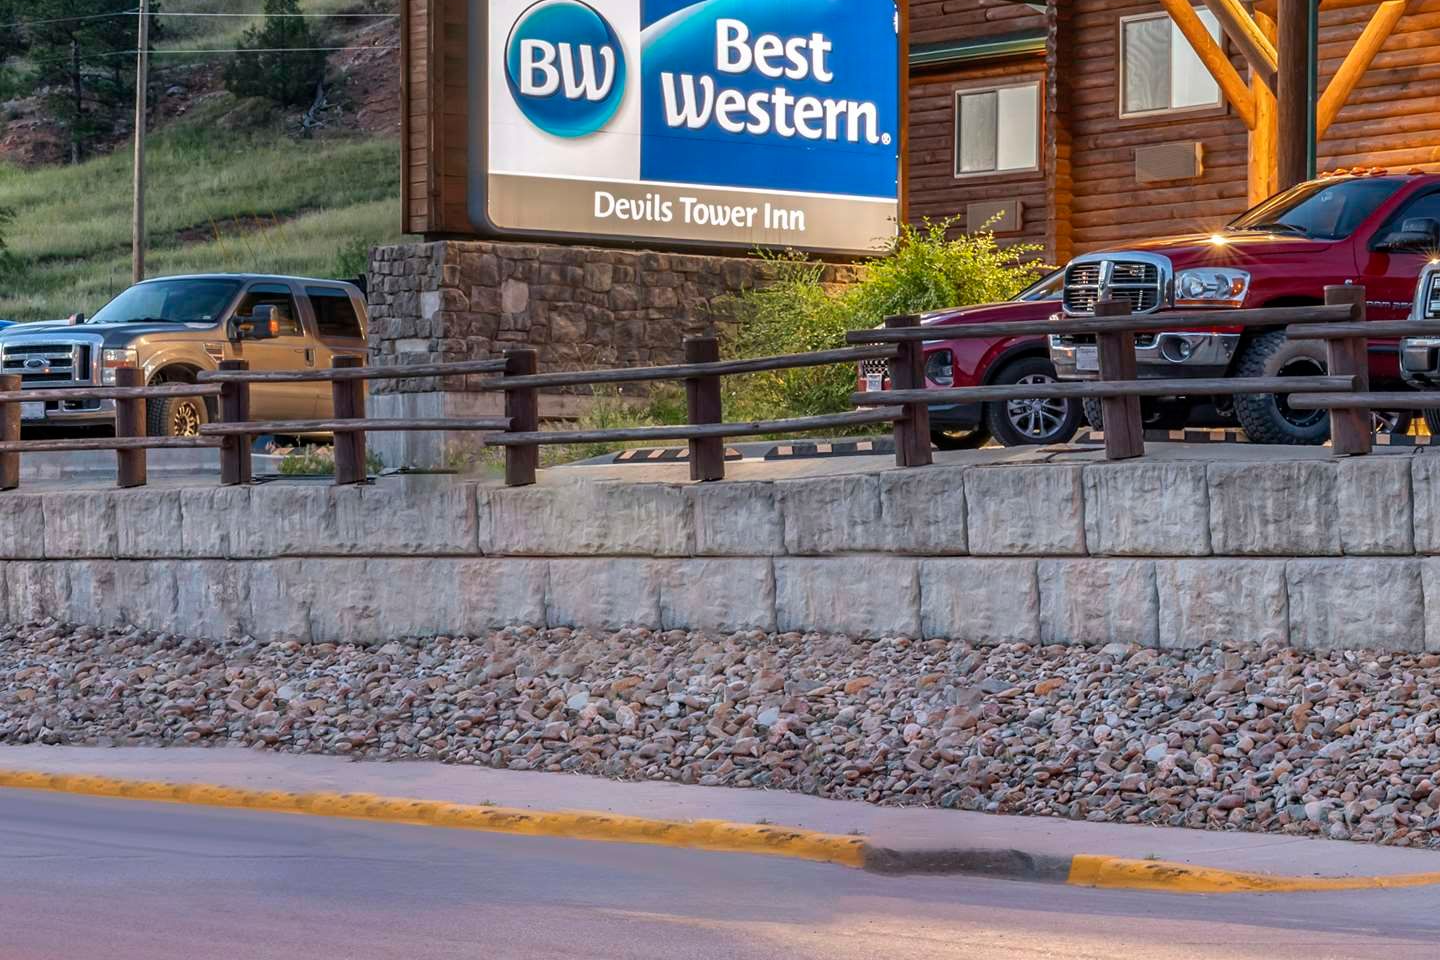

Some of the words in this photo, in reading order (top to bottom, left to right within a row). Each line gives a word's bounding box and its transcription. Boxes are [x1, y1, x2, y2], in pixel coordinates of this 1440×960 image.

[520, 39, 615, 101] BW
[716, 18, 833, 83] Best
[594, 191, 672, 223] Devils
[679, 196, 758, 229] Tower
[763, 203, 805, 231] Inn
